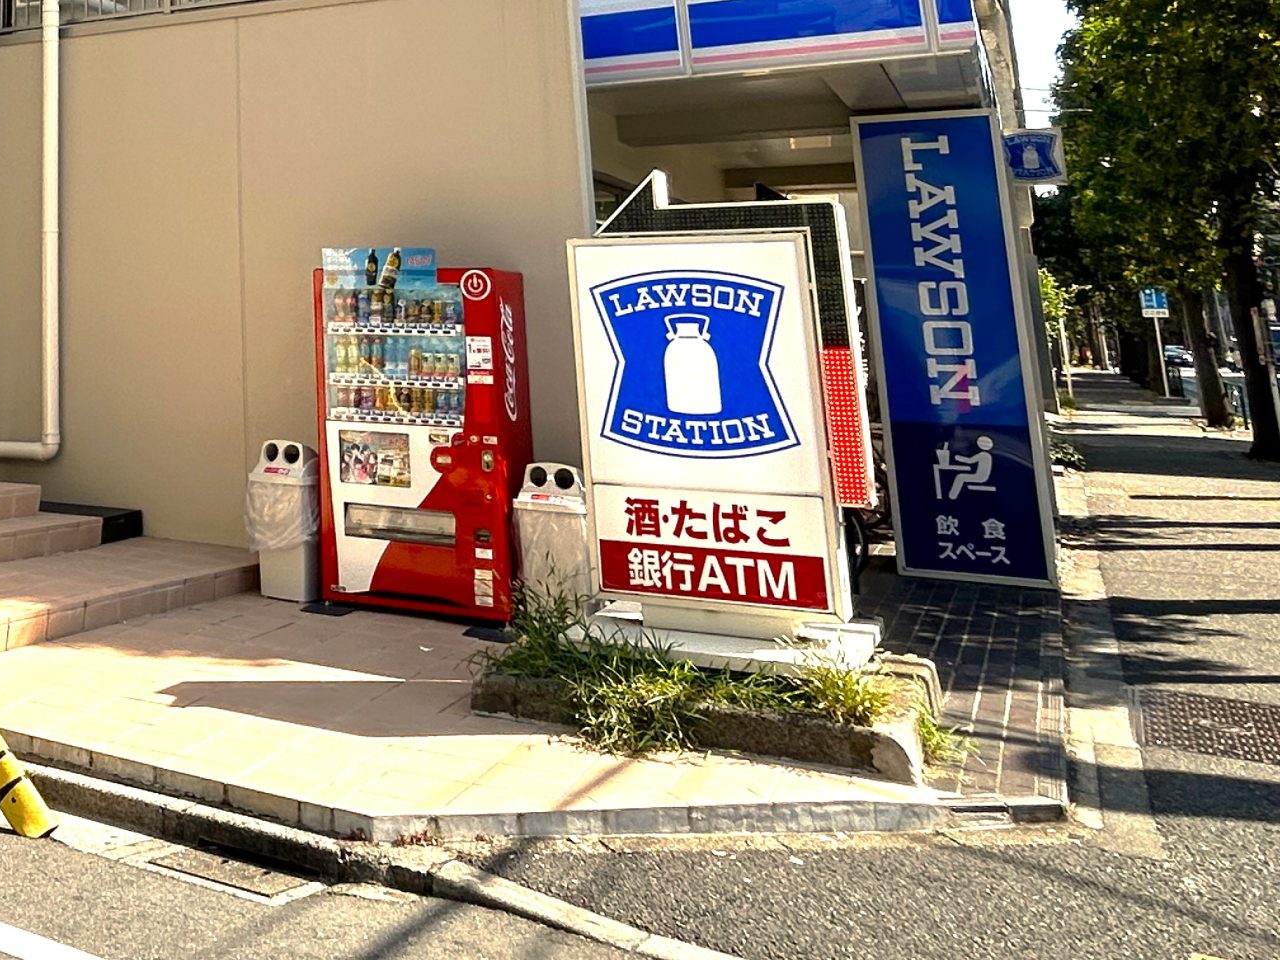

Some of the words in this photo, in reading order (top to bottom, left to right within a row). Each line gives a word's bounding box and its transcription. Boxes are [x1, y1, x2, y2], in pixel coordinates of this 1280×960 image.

[900, 134, 982, 408] LAWSON
[608, 283, 764, 318] LAWSON
[621, 408, 776, 446] STATION
[624, 496, 791, 548] 酒・たばこ
[627, 547, 797, 602] 銀行ATM
[938, 542, 1011, 565] スペース
